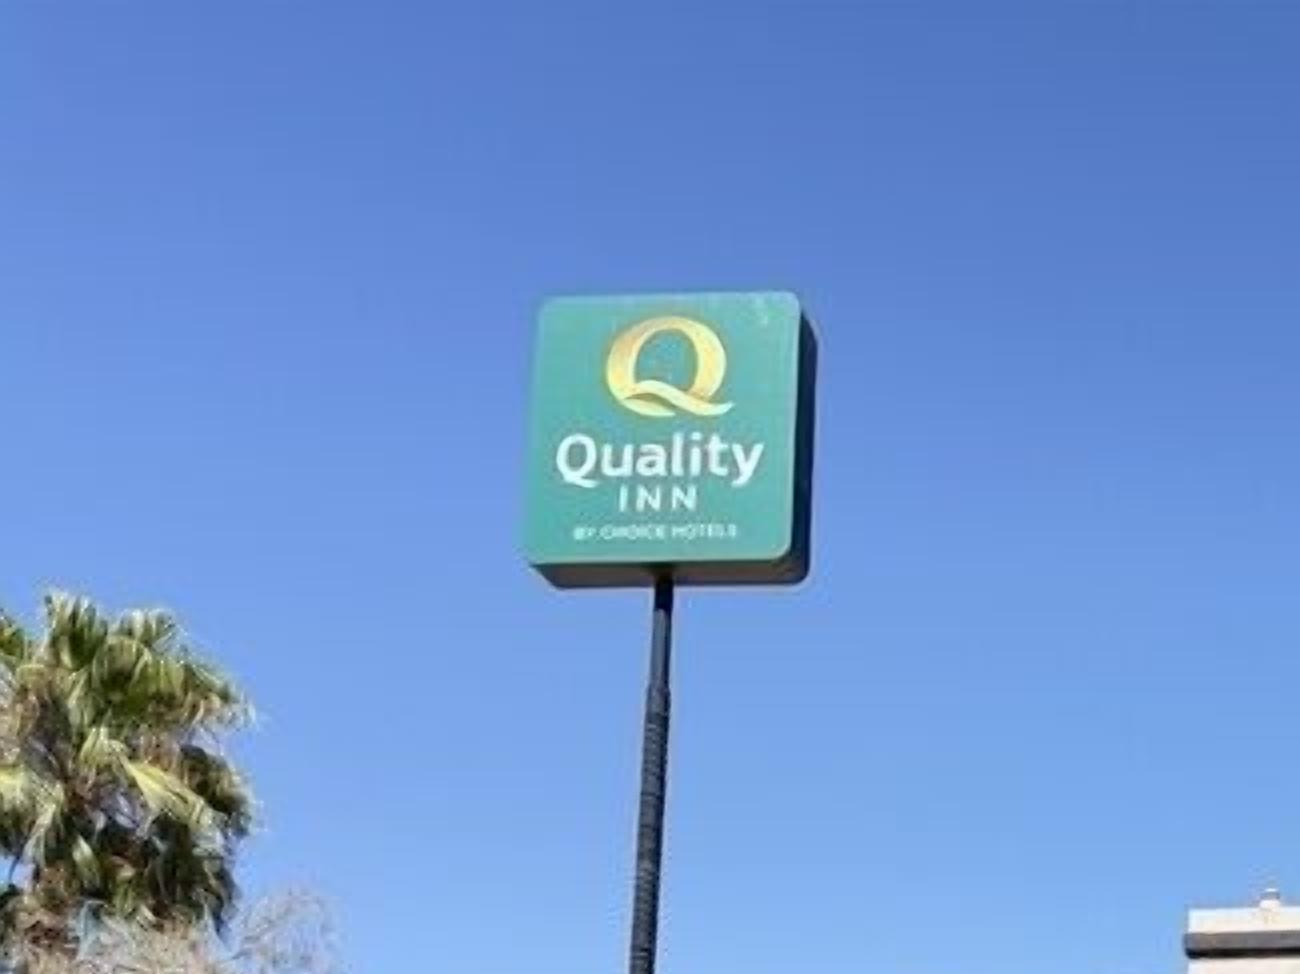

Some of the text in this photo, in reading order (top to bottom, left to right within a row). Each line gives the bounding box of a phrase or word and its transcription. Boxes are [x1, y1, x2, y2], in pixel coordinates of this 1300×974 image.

[556, 431, 764, 488] Quality
[618, 484, 698, 512] INN
[599, 523, 665, 541] CHOICE
[671, 522, 737, 540] HOTELS
